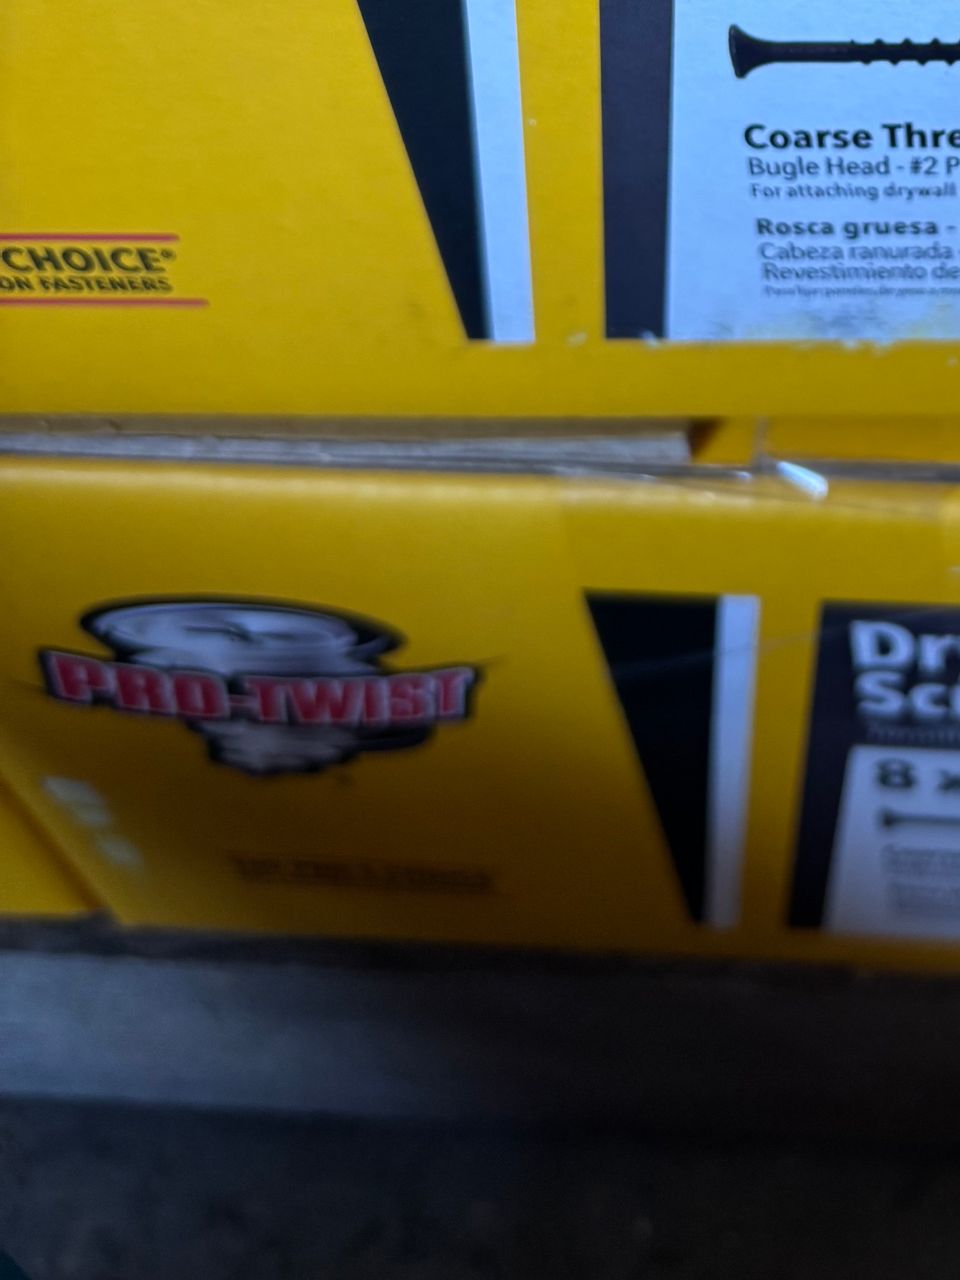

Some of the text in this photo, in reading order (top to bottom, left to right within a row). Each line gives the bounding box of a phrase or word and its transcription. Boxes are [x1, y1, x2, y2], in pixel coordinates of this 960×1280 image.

[744, 124, 873, 149] Coarse
[748, 156, 820, 180] Bugle
[826, 156, 890, 176] Head
[909, 156, 938, 176] #2
[751, 182, 781, 198] For
[787, 182, 879, 200] attaching
[883, 182, 957, 200] drywall
[756, 218, 834, 236] Rosca
[844, 221, 939, 240] gruesa
[759, 241, 844, 261] Cabeza
[850, 242, 954, 261] ranurada
[762, 261, 929, 280] Revestimiento
[39, 276, 175, 293] FASTENERS
[45, 648, 478, 726] PRO-TWIST
[873, 758, 917, 792] 8
